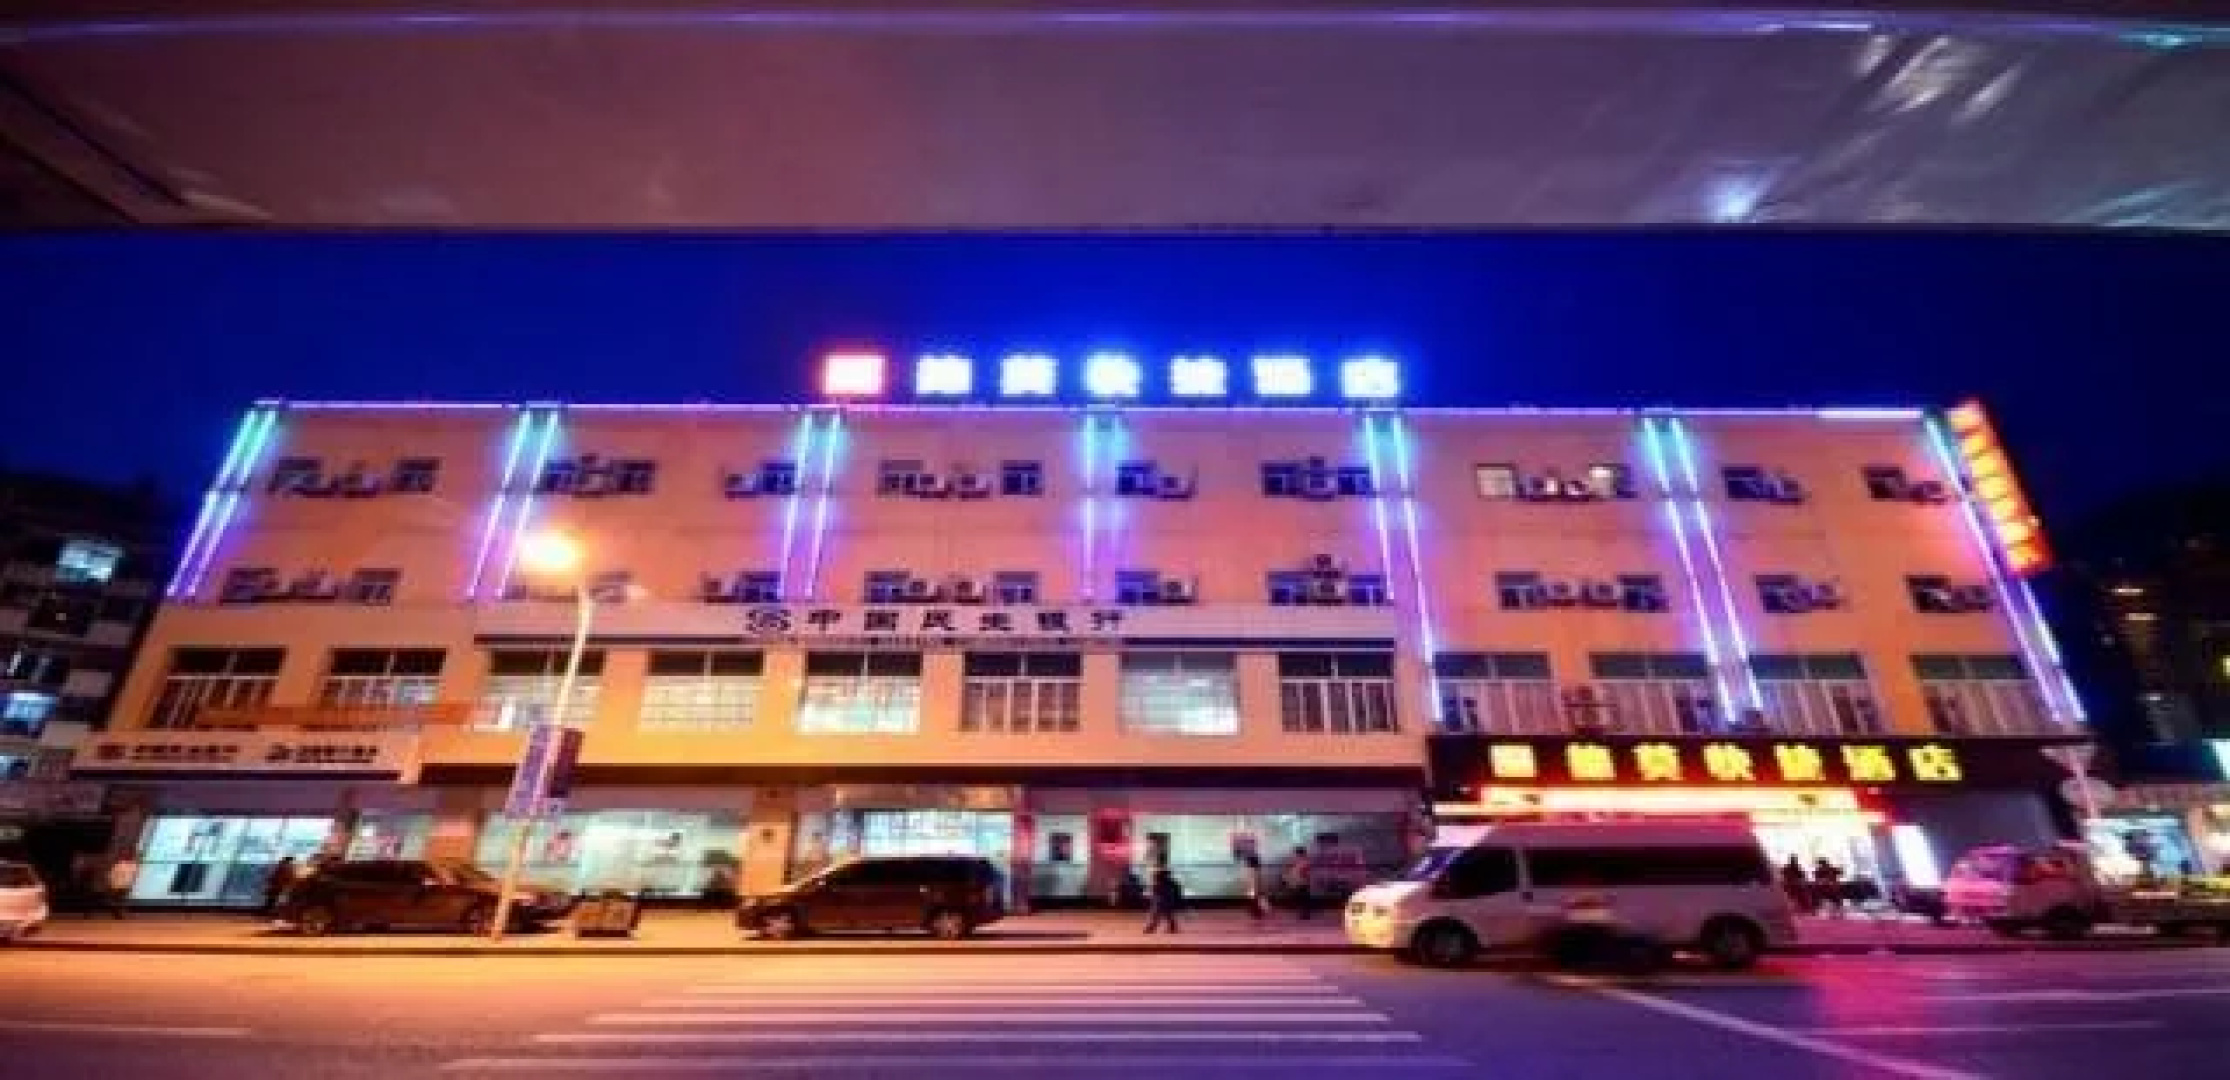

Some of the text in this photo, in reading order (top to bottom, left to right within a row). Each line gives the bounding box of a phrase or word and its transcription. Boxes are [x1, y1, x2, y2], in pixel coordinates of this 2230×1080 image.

[807, 608, 1124, 633] 中国民生银行
